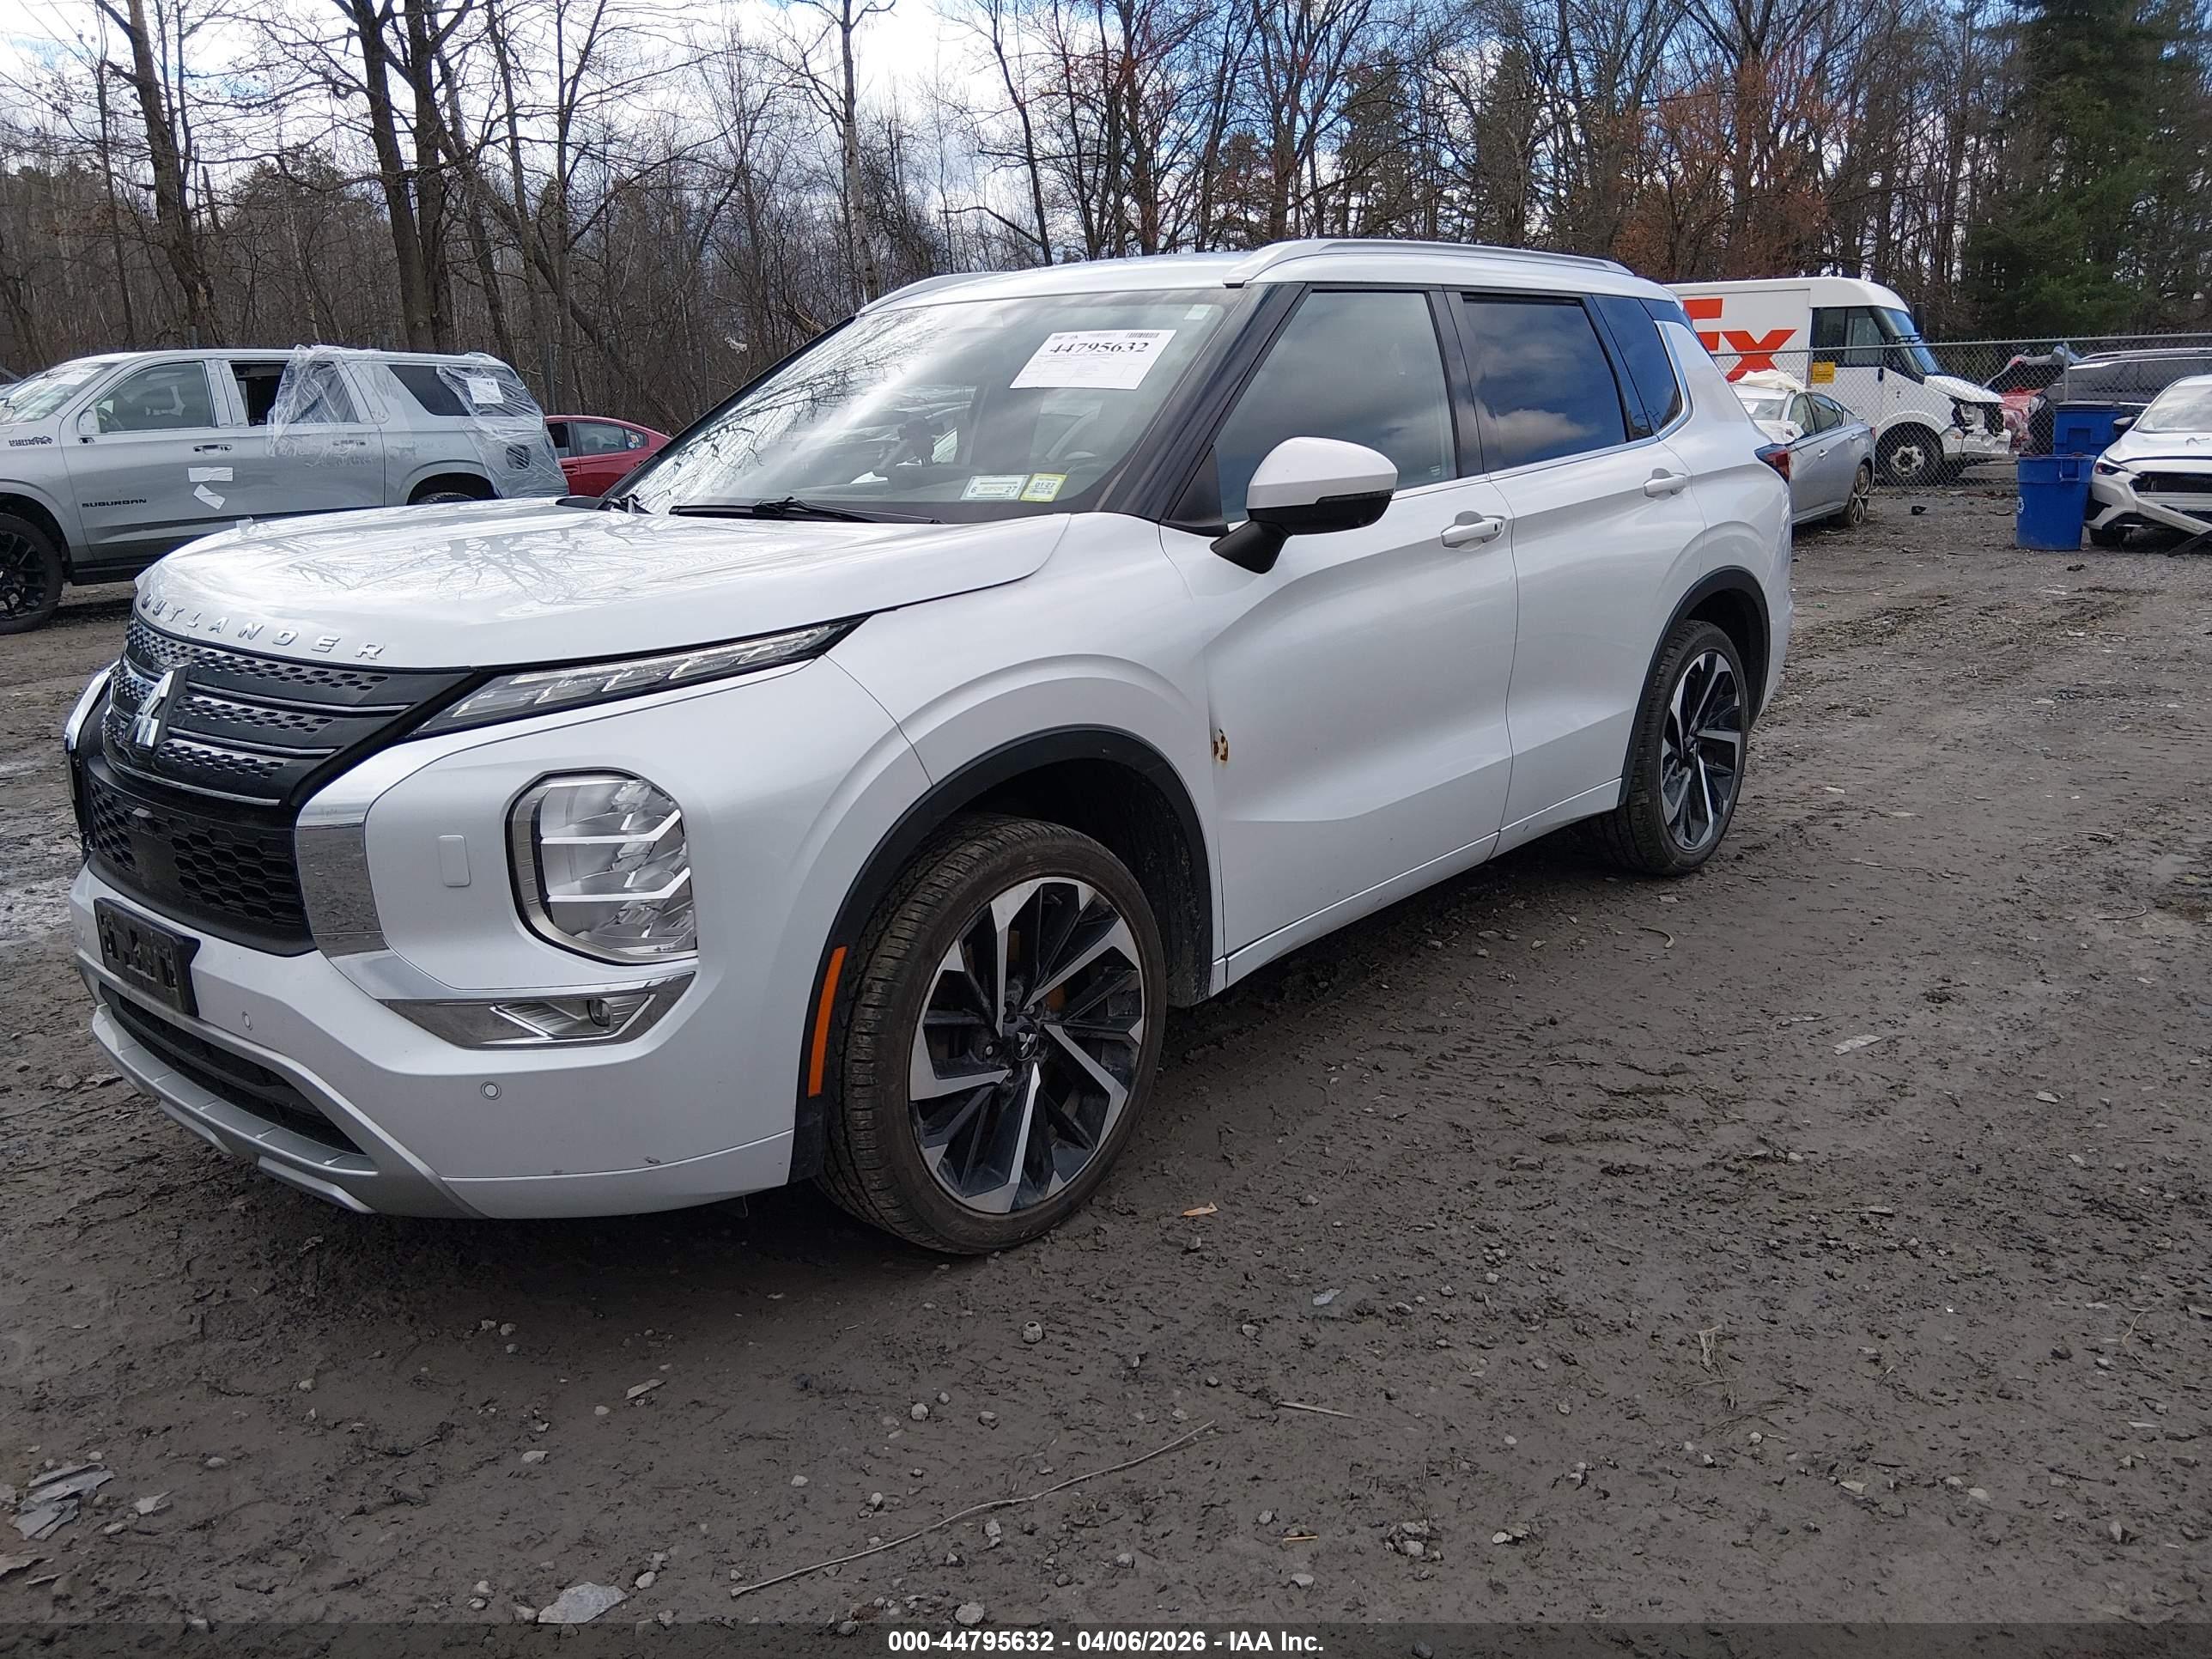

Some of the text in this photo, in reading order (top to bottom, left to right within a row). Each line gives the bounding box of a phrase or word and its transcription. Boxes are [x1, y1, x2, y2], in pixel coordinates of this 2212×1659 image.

[1048, 342, 1150, 354] 44795632
[82, 498, 147, 508] SUBURBAN
[141, 592, 386, 660] OUTLANDER
